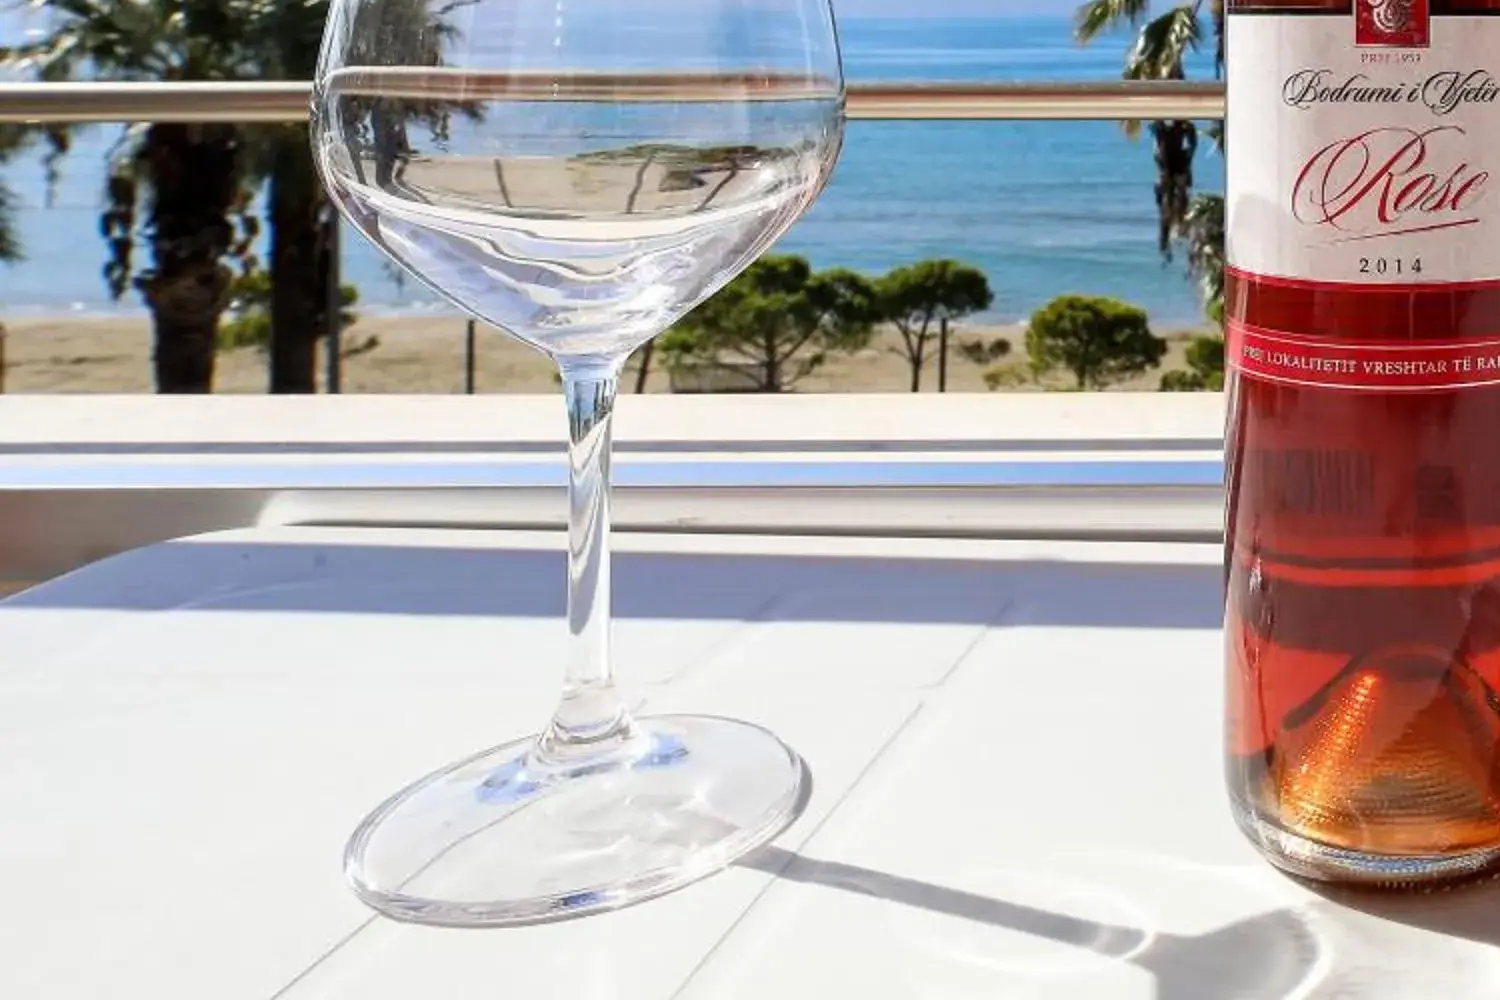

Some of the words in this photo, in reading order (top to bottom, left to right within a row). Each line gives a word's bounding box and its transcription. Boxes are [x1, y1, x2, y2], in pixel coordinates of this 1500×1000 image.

[1282, 69, 1403, 110] Bodrumi
[1292, 126, 1489, 231] Rose
[1359, 258, 1422, 273] 2014
[1267, 351, 1357, 373] LOKALITETIT
[1363, 360, 1447, 375] VRESHTAR
